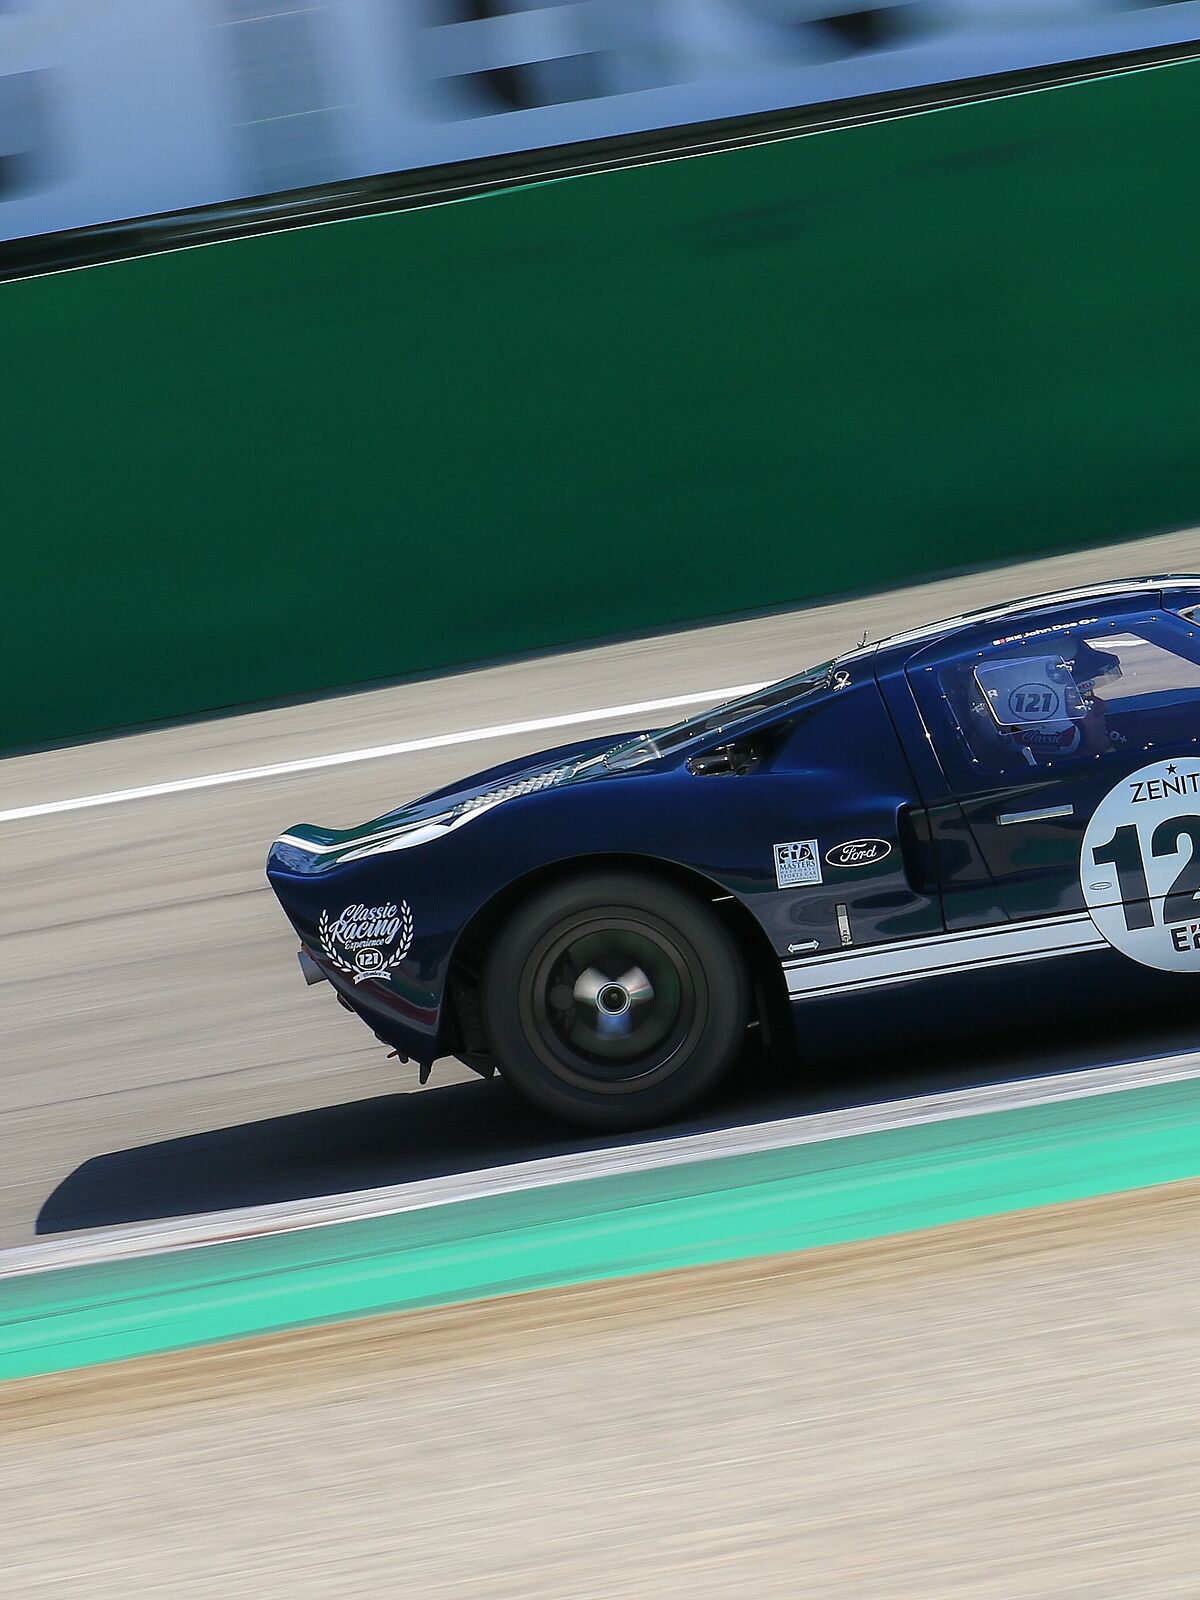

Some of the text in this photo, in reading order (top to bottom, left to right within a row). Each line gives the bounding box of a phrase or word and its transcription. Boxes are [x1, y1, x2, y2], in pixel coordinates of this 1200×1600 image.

[1024, 627, 1052, 638] John
[1015, 693, 1053, 713] 121
[840, 843, 877, 862] Ford
[780, 860, 816, 871] MASTERS
[340, 902, 398, 923] Classic
[328, 917, 403, 944] Racing
[344, 938, 384, 951] Experience
[359, 953, 379, 966] 121
